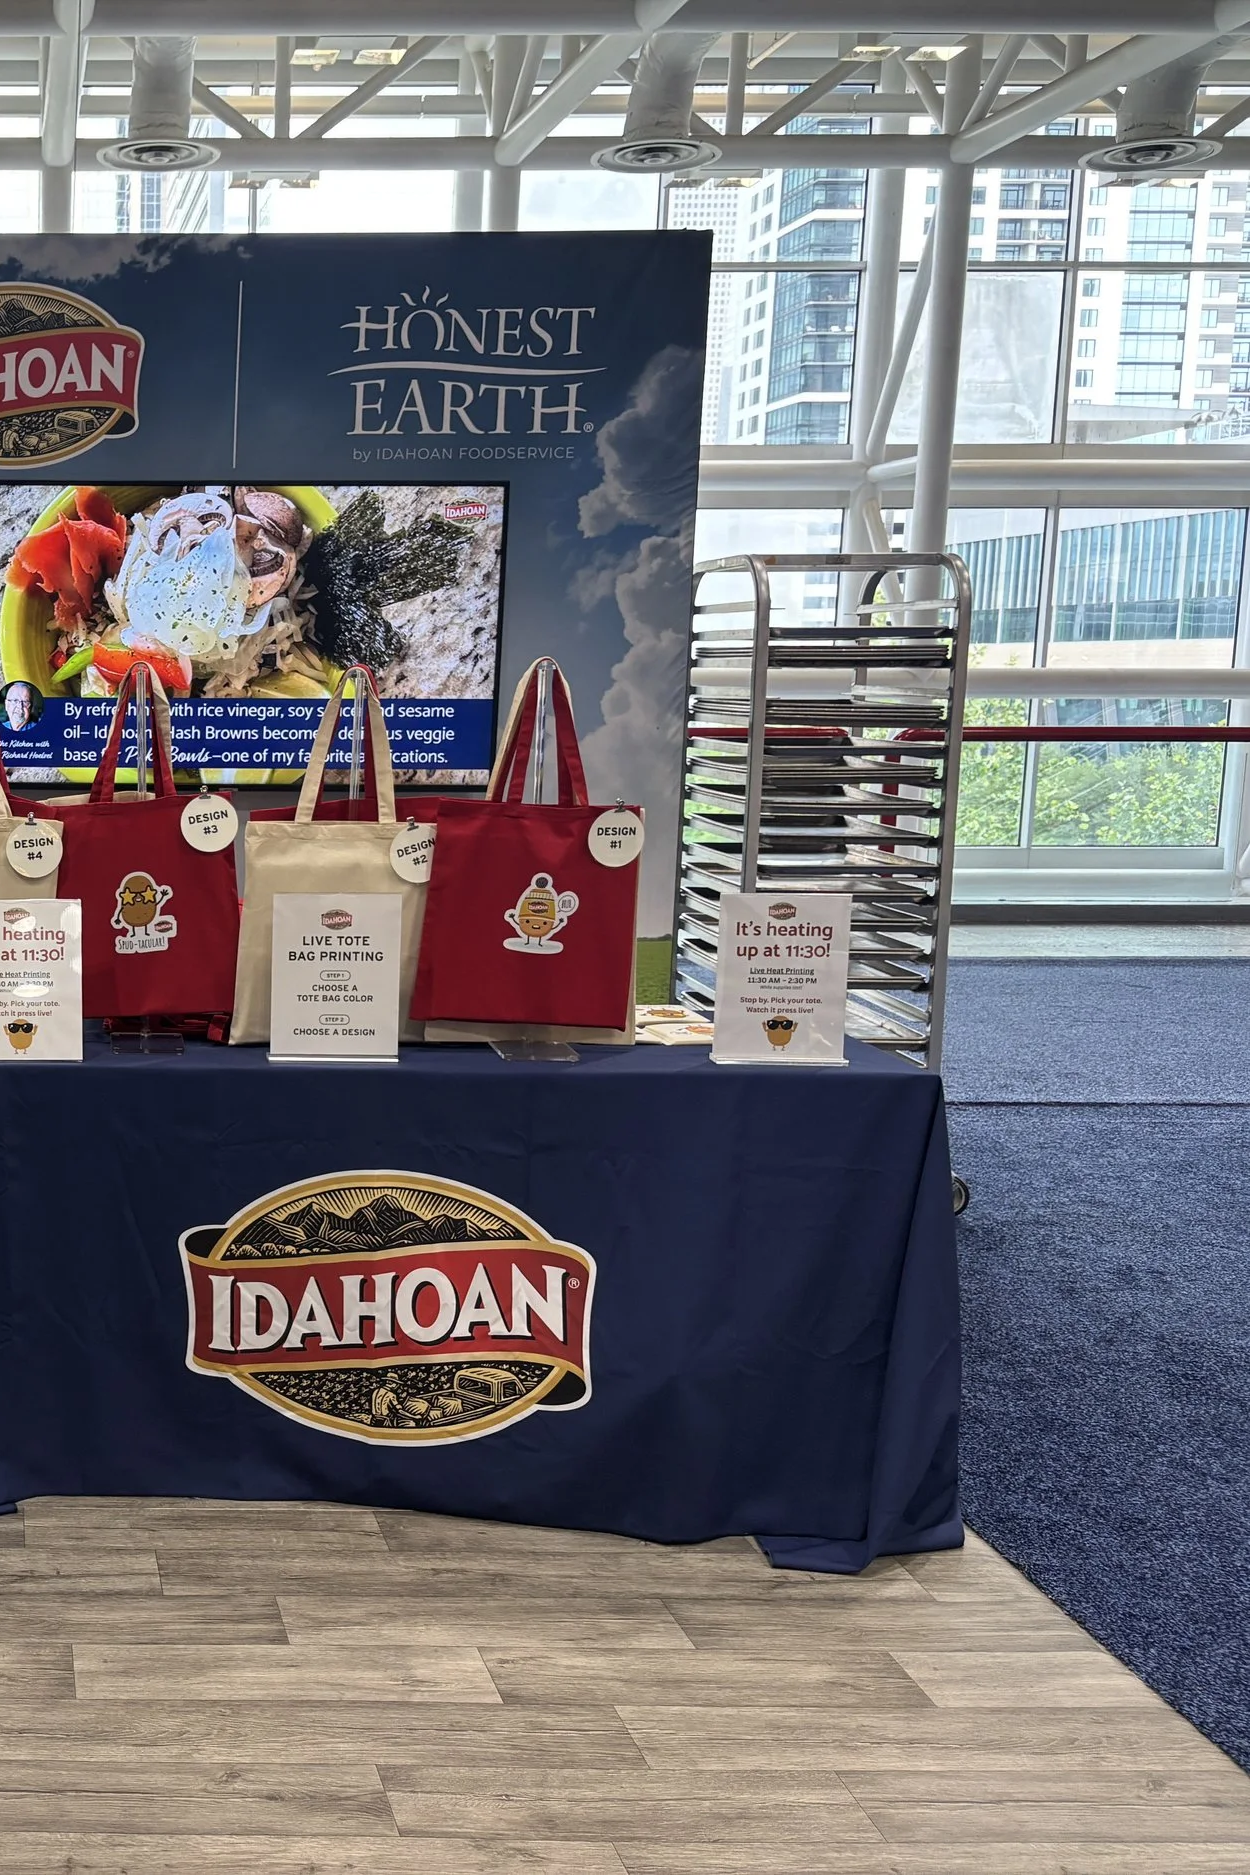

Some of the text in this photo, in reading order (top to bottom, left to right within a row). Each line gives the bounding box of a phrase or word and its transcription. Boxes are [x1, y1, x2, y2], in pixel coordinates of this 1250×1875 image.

[340, 304, 596, 357] HONEST
[347, 379, 587, 434] EARTH
[353, 446, 575, 463] by IDAHOAN FOODSERVICE
[446, 504, 486, 519] IDAHOAN
[64, 702, 455, 722] By rice vinegar, soy sesame
[207, 725, 259, 740] Browns
[406, 726, 455, 745] veggie
[35, 740, 50, 748] with
[1, 750, 29, 760] Richard
[64, 749, 97, 762] base
[253, 749, 268, 762] of
[271, 752, 293, 767] my
[188, 809, 229, 826] DESIGN
[203, 825, 219, 836] #3
[596, 827, 637, 836] DESIGN
[14, 837, 54, 849] DESIGN
[397, 838, 436, 859] DESIGN
[609, 840, 622, 849] #1
[27, 851, 43, 860] #4
[412, 854, 428, 866] #2
[323, 915, 352, 926] IDAHOAN
[3, 926, 66, 944] heating
[736, 921, 833, 940] It's heating
[302, 936, 370, 946] LIVE TOTE
[0, 949, 17, 961] at
[21, 947, 65, 962] 11:30!
[288, 951, 384, 962] BAG PRINTING
[736, 943, 831, 960] up at 11:30!
[5, 970, 22, 978] Heat
[23, 970, 51, 979] Printing
[750, 967, 815, 976] Live Heat Printing
[787, 977, 804, 985] 2:30
[312, 984, 358, 992] CHOOSE A
[0, 1000, 9, 1008] by.
[343, 995, 374, 1003] COLOR
[740, 996, 757, 1004] Stop
[746, 1006, 769, 1014] Watch
[293, 1028, 330, 1036] CHOOSE
[342, 1028, 375, 1036] DESIGN
[208, 1262, 570, 1352] IDAHOAN
